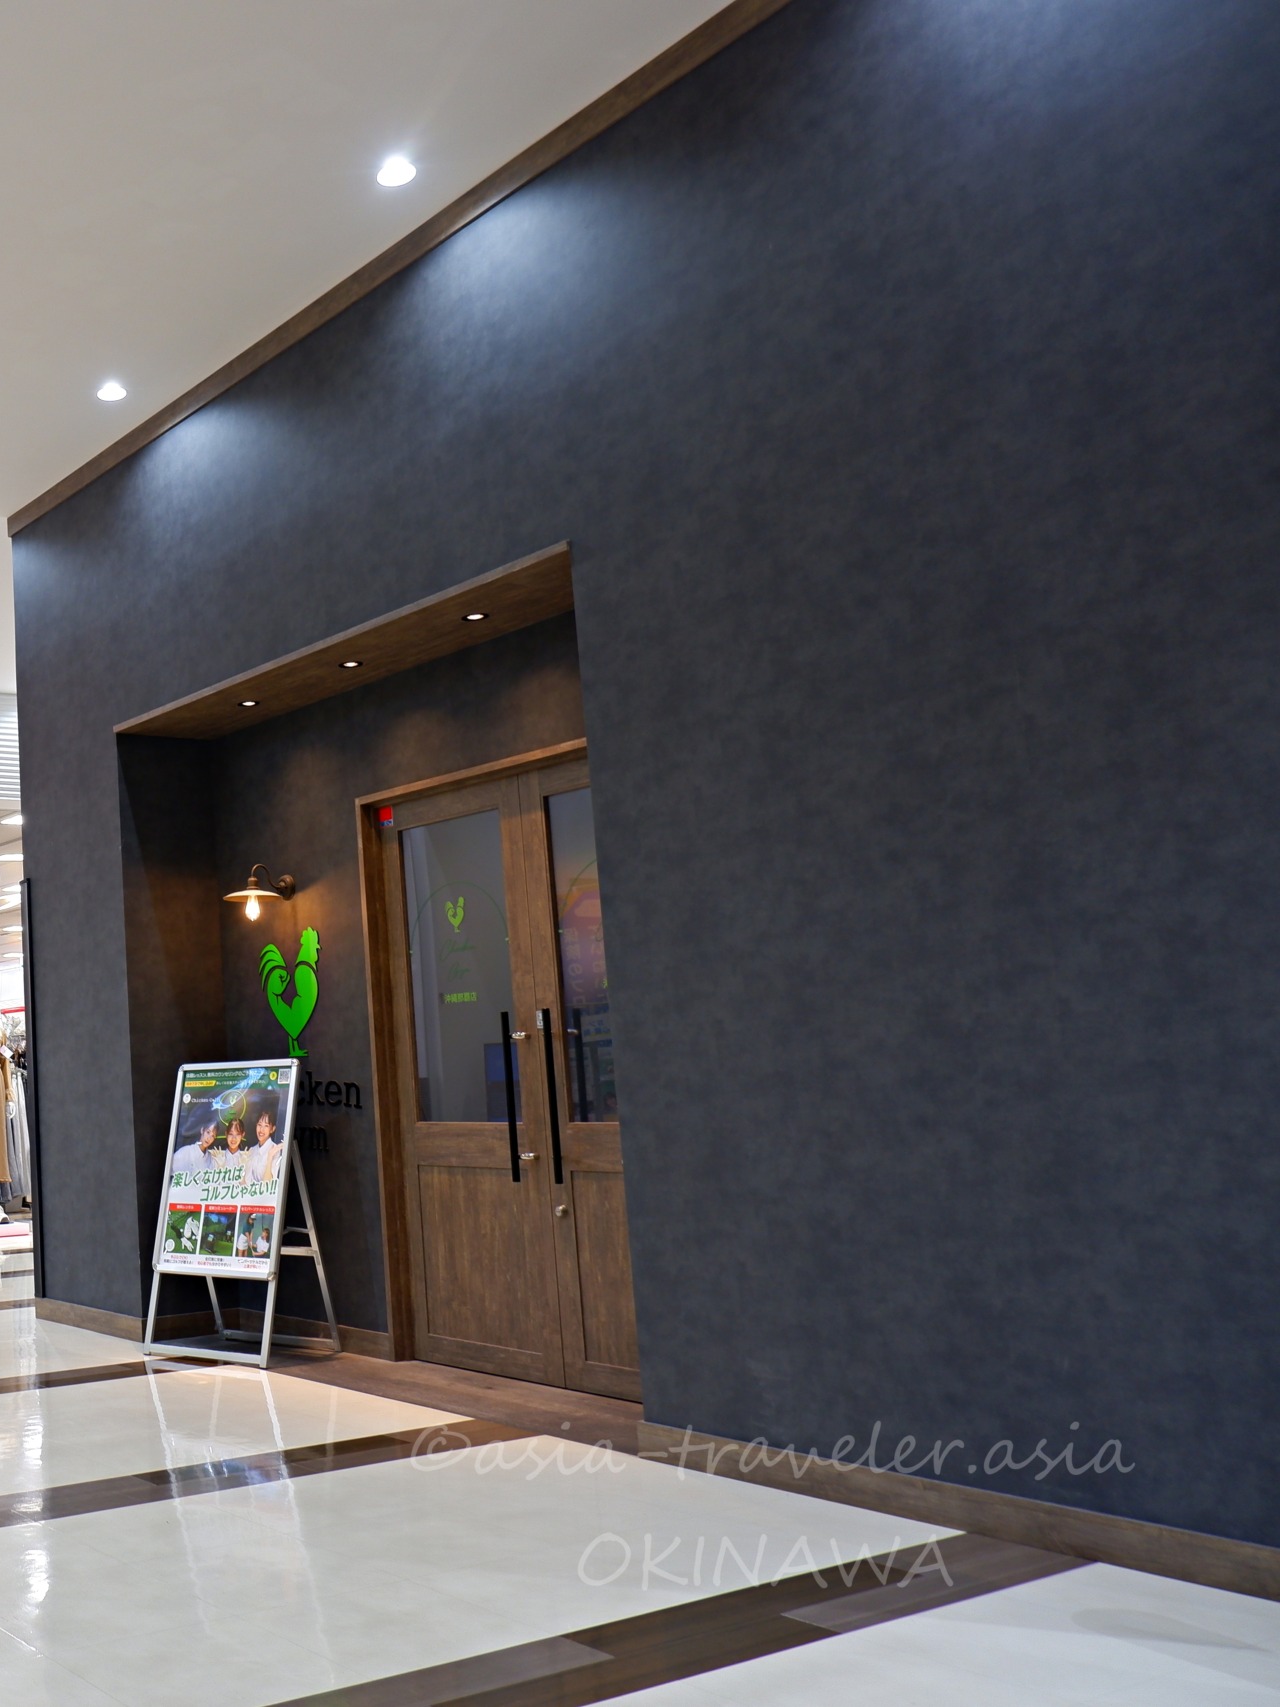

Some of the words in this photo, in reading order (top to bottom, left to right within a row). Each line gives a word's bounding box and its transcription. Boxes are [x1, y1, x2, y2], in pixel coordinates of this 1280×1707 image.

[172, 1165, 245, 1189] 楽しくなければ
